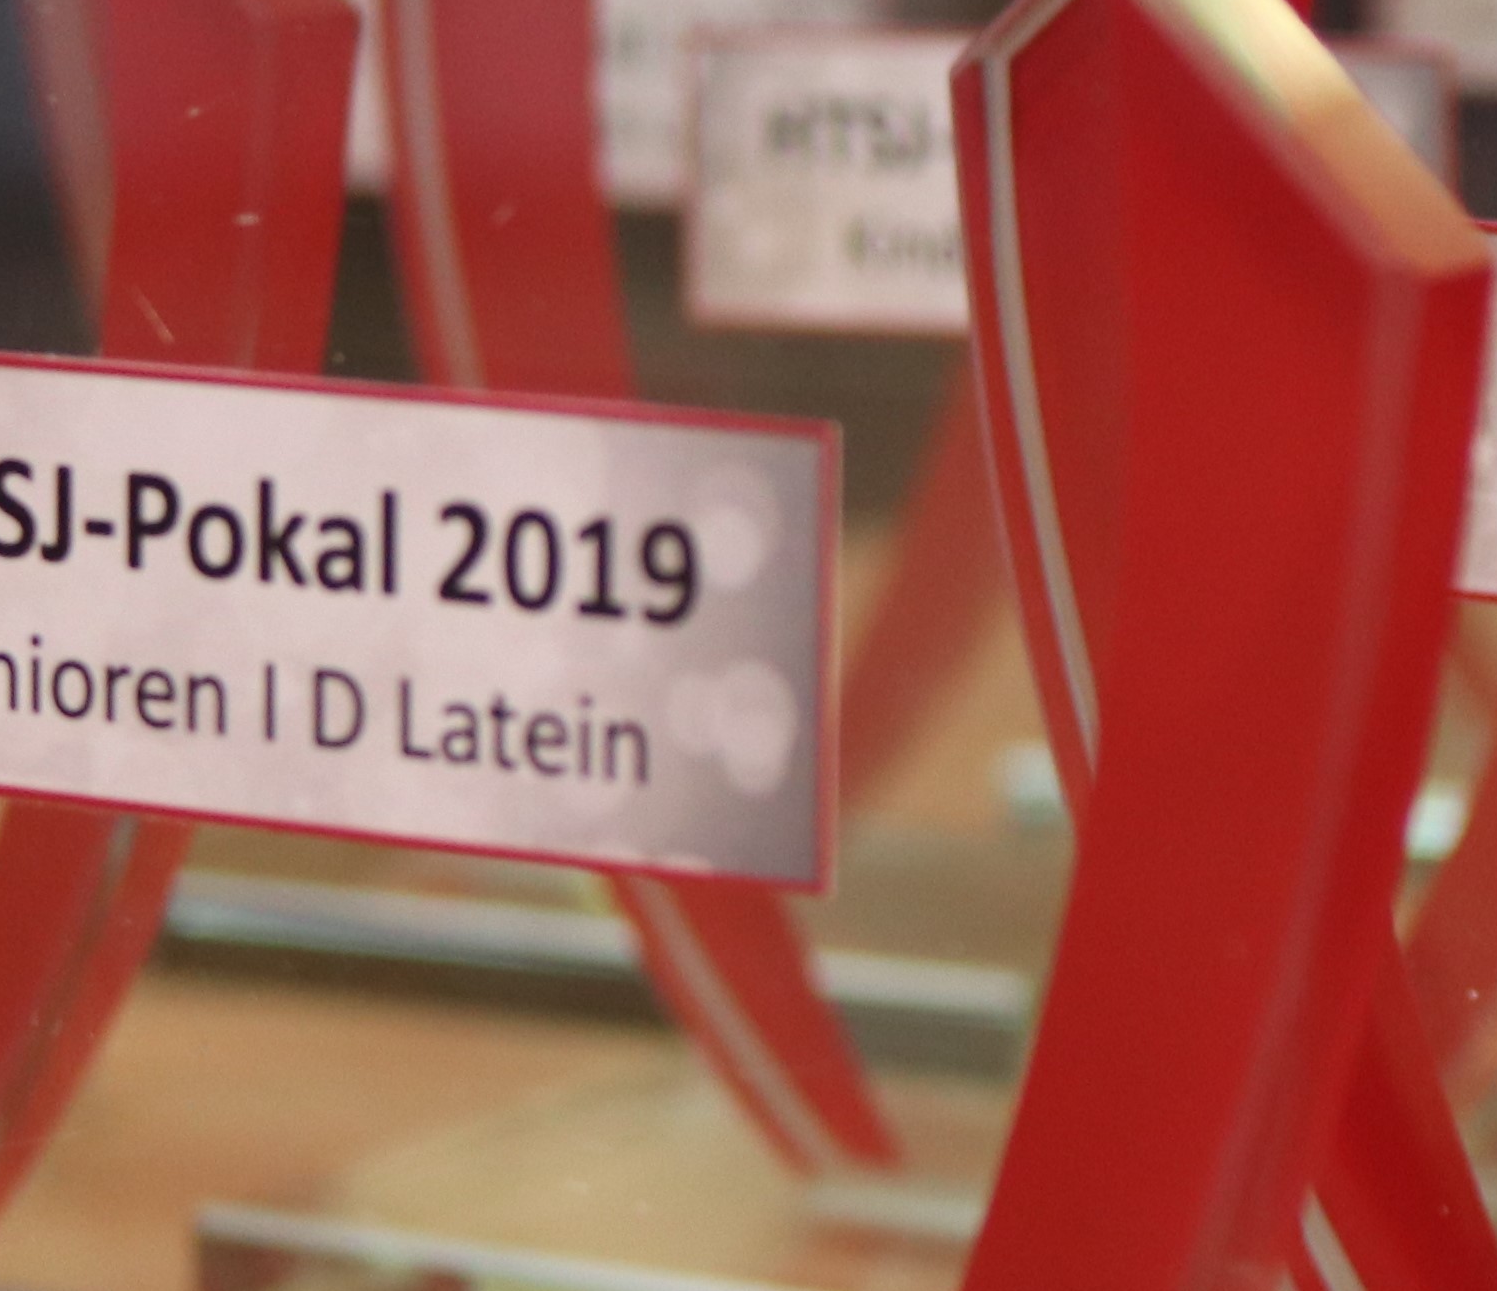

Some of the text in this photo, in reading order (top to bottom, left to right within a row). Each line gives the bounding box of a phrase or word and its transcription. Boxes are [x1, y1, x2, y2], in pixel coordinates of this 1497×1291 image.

[435, 498, 703, 631] 2019
[308, 665, 369, 753] D
[395, 675, 652, 788] Latein
